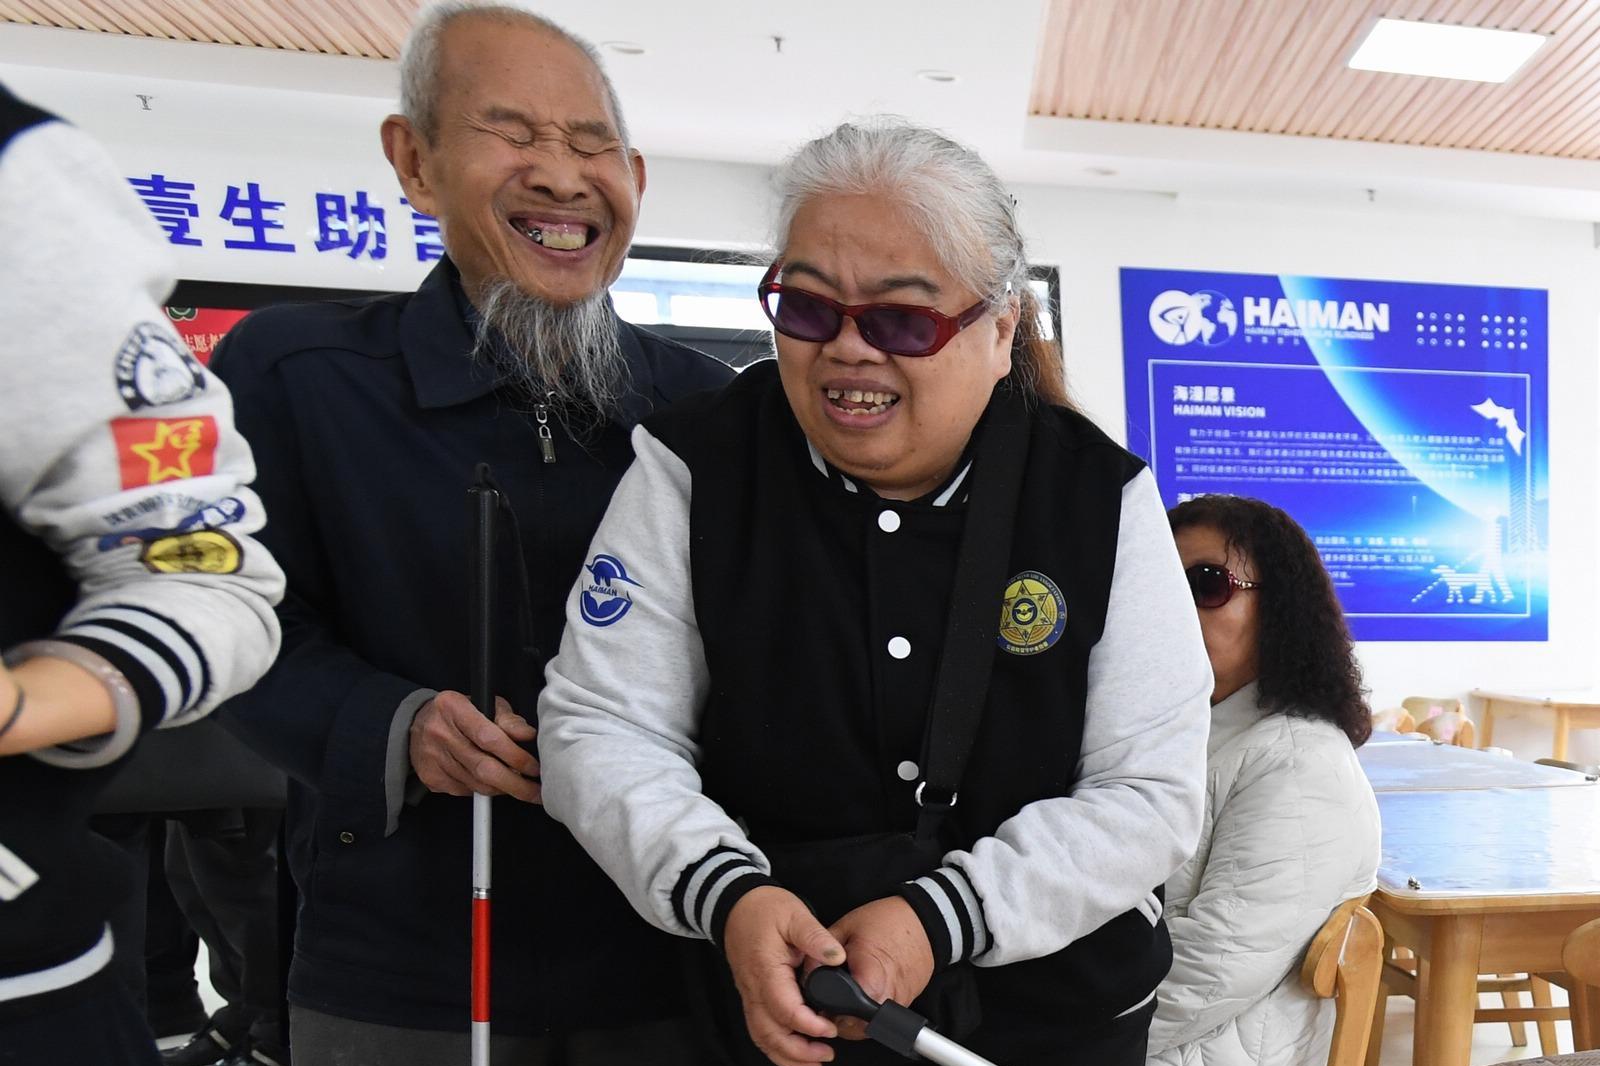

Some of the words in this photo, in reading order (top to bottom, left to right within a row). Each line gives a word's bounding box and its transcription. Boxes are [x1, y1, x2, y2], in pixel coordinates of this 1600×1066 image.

[1243, 297, 1390, 332] HAIMAN
[1173, 404, 1222, 417] HAIMAN
[1223, 405, 1266, 418] VISION
[588, 584, 617, 597] HAIMAN
